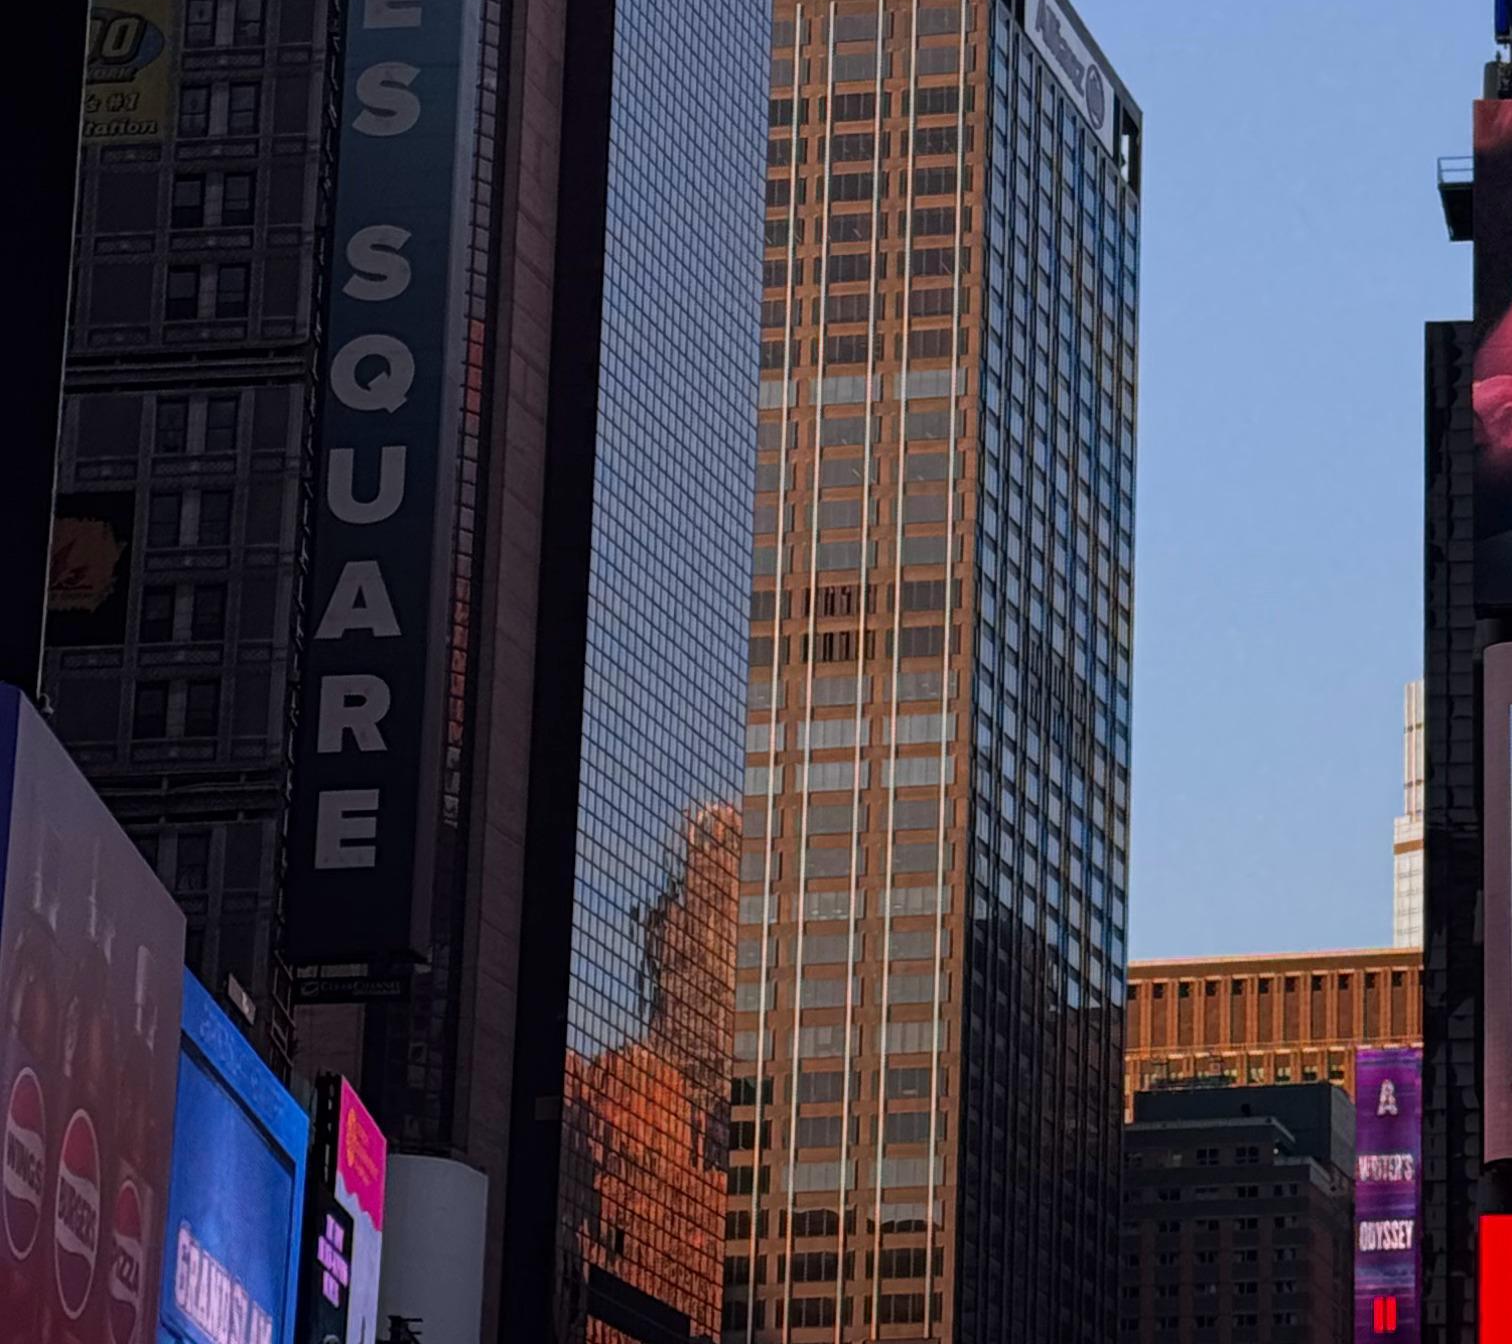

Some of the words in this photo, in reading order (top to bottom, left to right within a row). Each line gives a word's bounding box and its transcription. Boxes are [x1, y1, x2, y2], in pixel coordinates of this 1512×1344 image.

[313, 224, 416, 871] SQUARE
[1375, 1078, 1399, 1118] A
[1359, 1220, 1414, 1252] ODYSSEY
